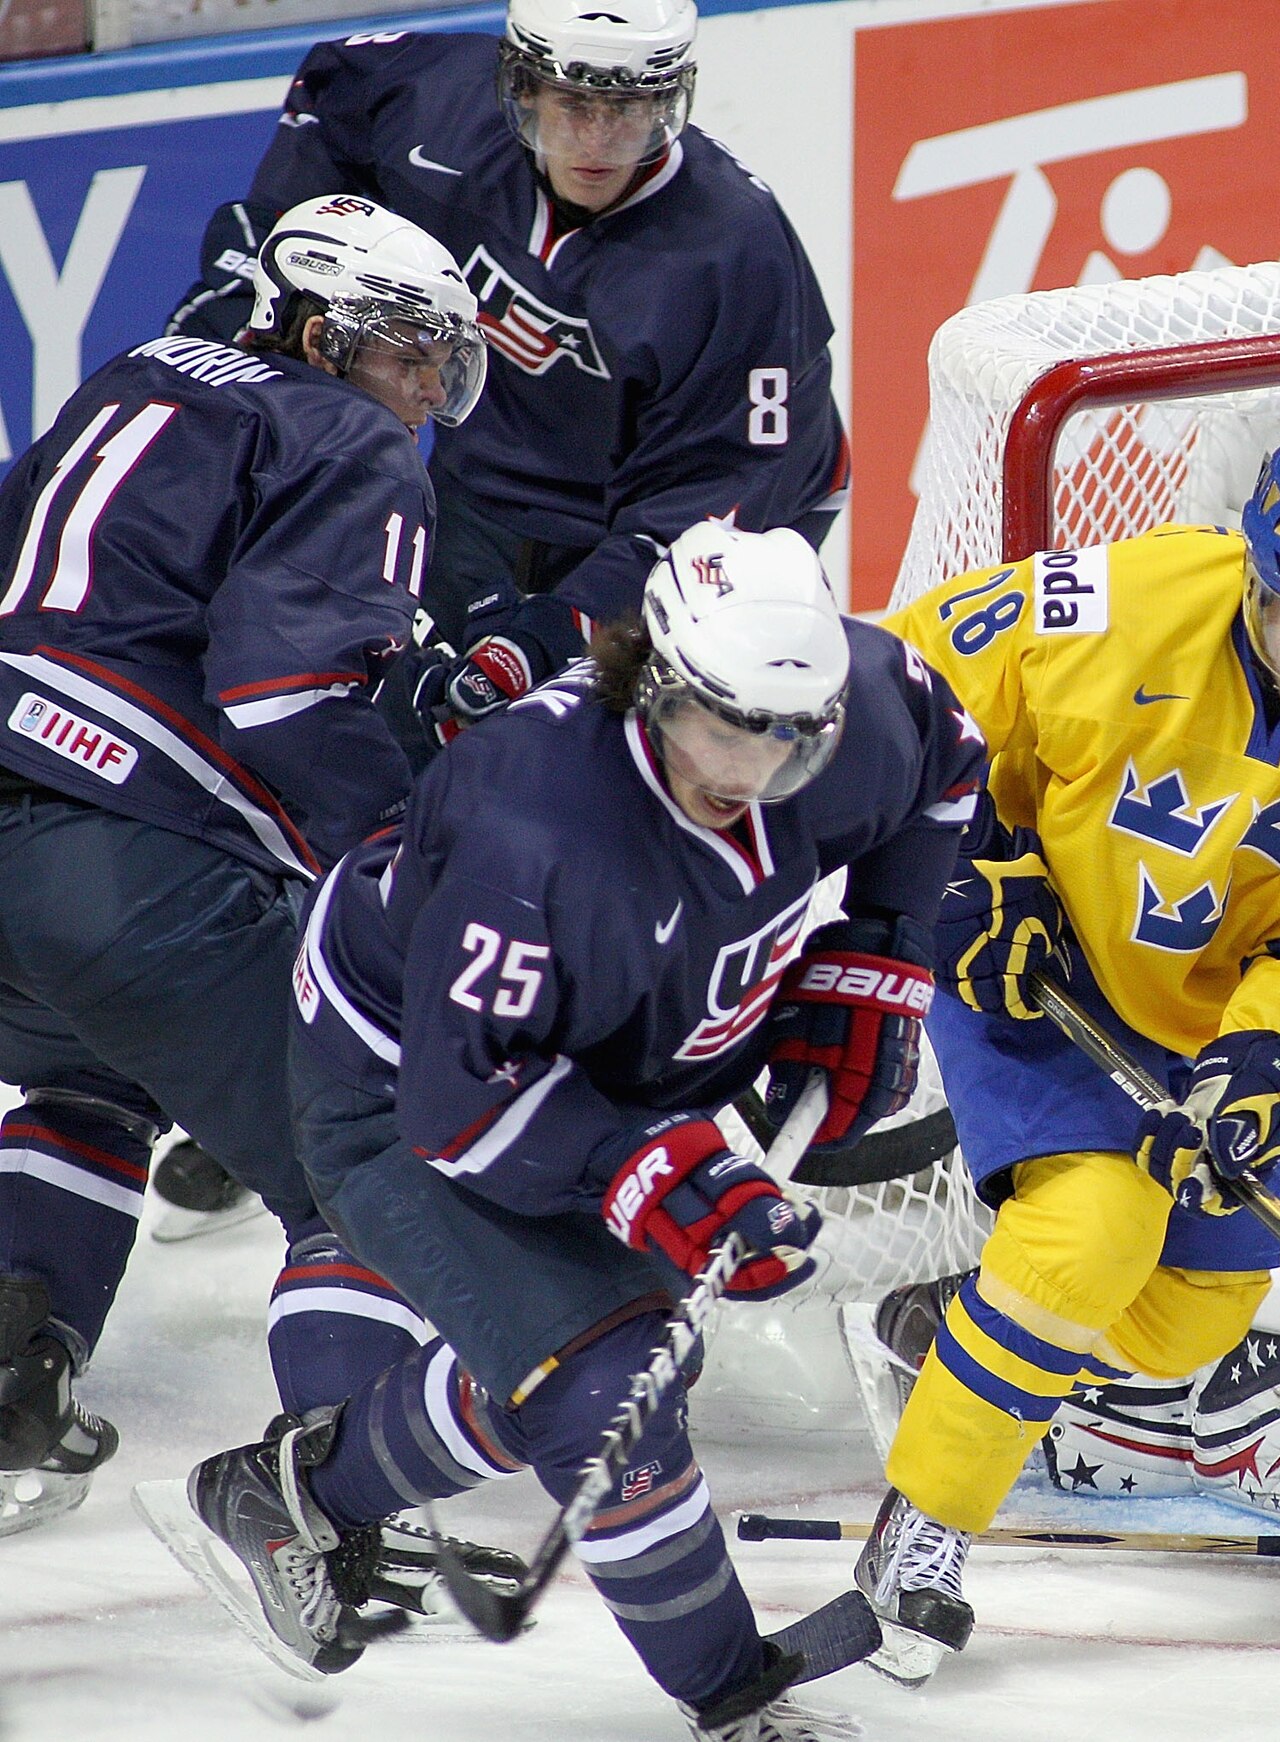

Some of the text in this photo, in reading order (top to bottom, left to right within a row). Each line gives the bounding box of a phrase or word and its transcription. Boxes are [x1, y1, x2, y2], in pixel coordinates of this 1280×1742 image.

[127, 333, 284, 388] MORIN
[748, 367, 789, 446] 8
[0, 399, 181, 616] 11
[382, 511, 427, 600] 11
[1042, 549, 1096, 630] oda
[937, 567, 1027, 657] 28
[41, 711, 128, 770] IIHF
[448, 921, 551, 1018] 25
[606, 1146, 676, 1248] UER
